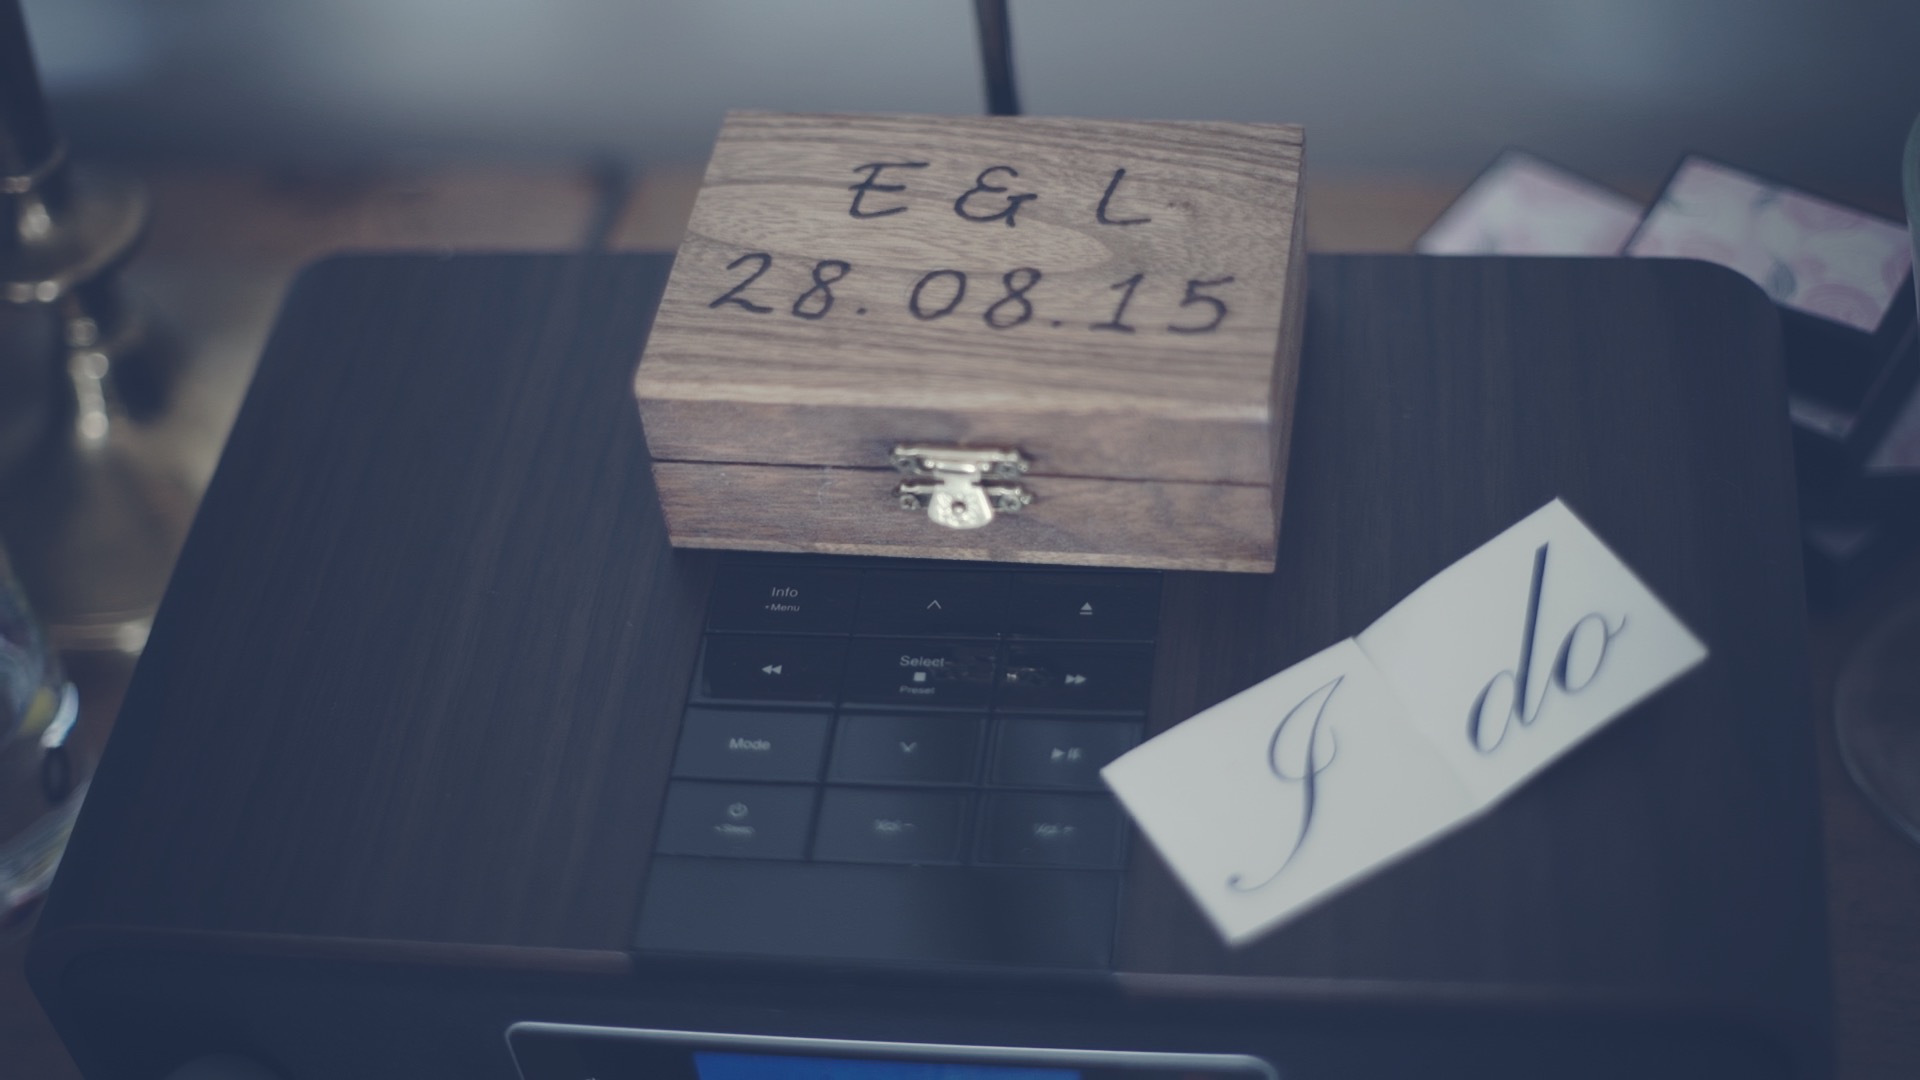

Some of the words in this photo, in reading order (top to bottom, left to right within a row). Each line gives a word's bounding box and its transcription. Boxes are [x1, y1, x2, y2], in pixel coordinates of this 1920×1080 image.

[847, 160, 931, 219] E
[953, 164, 1038, 228] &
[1096, 167, 1152, 226] L
[771, 586, 799, 598] Info
[899, 655, 945, 667] Select
[1224, 673, 1347, 893] I
[1466, 541, 1629, 756] do
[728, 737, 772, 751] Mode
